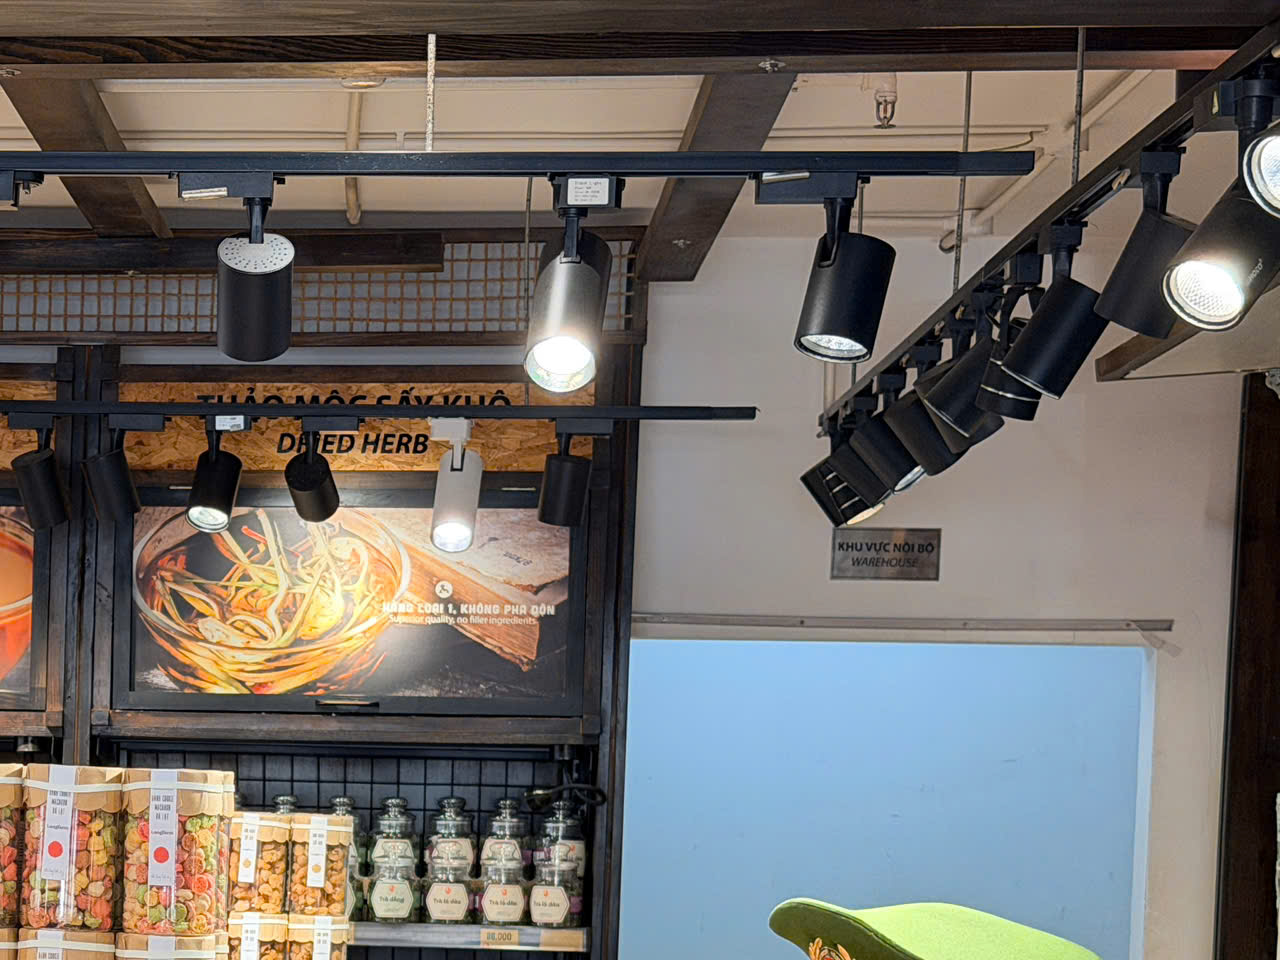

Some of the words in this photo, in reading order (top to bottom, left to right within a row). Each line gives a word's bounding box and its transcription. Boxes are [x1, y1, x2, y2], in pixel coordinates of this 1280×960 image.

[360, 433, 429, 455] HERB
[838, 542, 863, 552] KHU
[866, 542, 891, 555] VỰC
[851, 557, 919, 568] WAREHOUSE
[457, 617, 468, 625] no
[469, 615, 489, 625] filler
